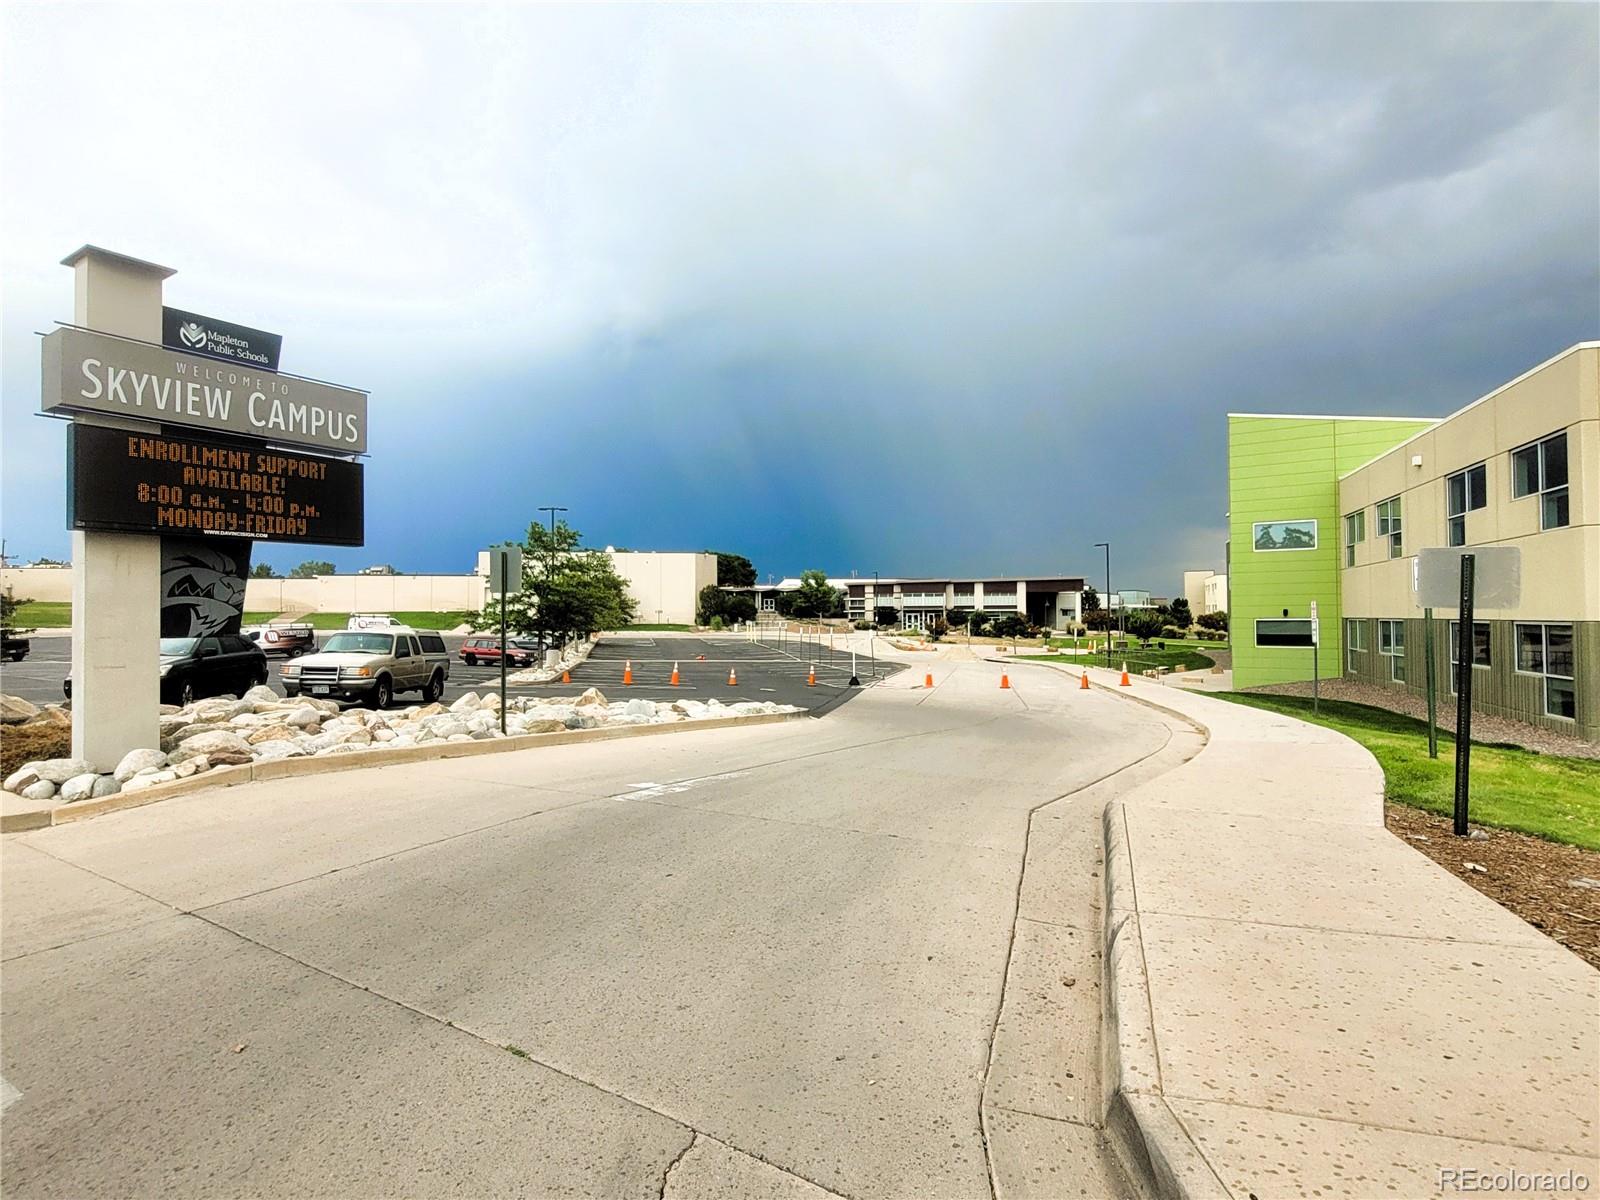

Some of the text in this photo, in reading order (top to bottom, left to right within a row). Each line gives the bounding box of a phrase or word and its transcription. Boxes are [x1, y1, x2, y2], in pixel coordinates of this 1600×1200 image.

[207, 330, 248, 349] Mapleton
[207, 342, 269, 364] Public Schools
[176, 362, 289, 396] WELCOME TO
[80, 358, 358, 443] SKYVIEW CAMPUS
[128, 436, 327, 480] ENROLLMENT SUPPORT
[183, 466, 286, 495] AVAILABLE!
[137, 482, 183, 505] 8:00
[246, 493, 284, 514] 4:00
[157, 506, 307, 535] MONDAY-FRIDAY
